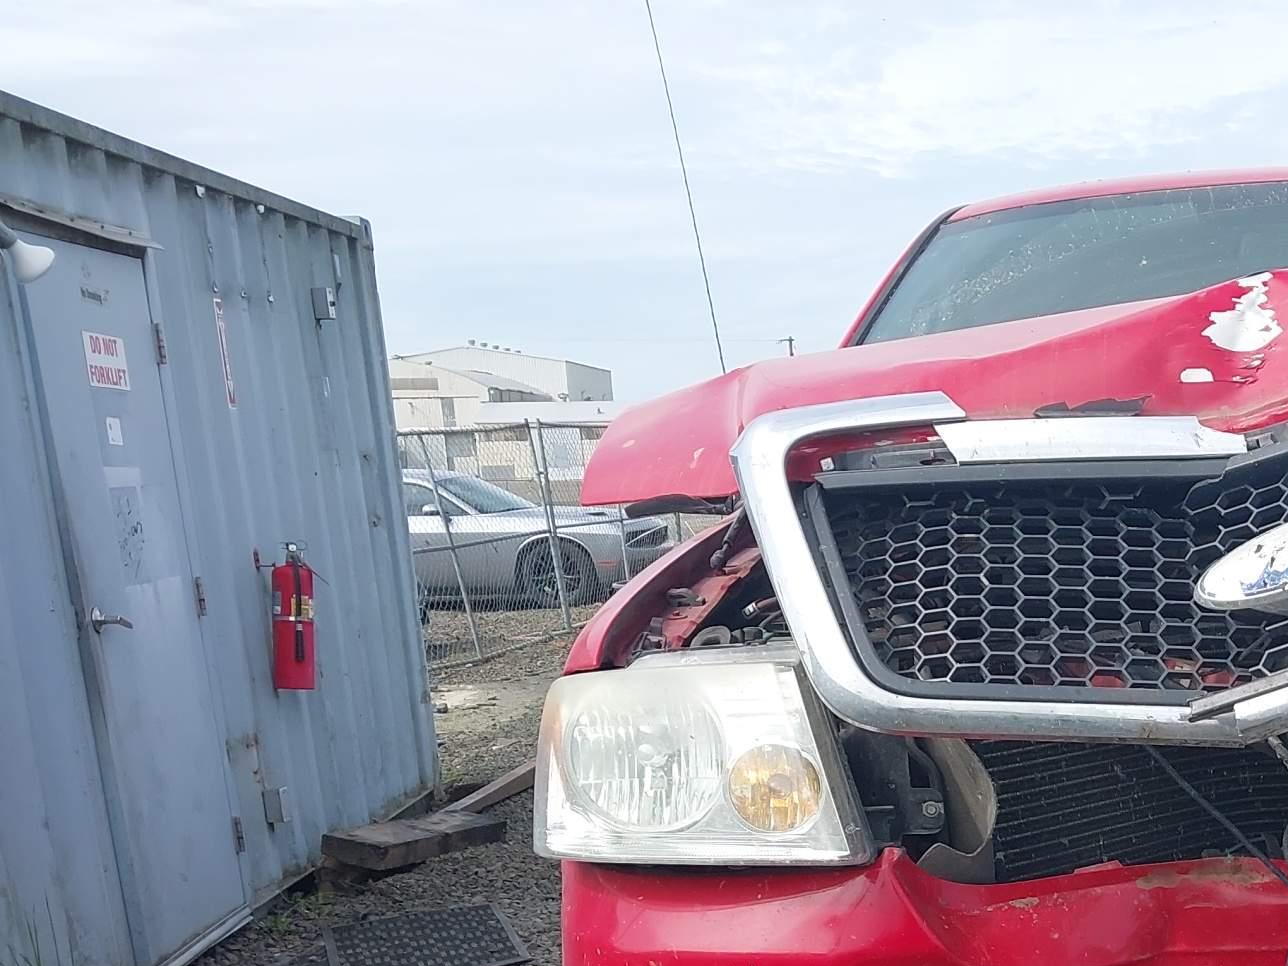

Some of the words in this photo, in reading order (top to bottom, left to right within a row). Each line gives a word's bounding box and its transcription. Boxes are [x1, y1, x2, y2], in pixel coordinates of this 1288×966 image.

[89, 335, 101, 355] DO
[102, 337, 118, 358] NOT
[89, 364, 128, 387] FORKLIFT
